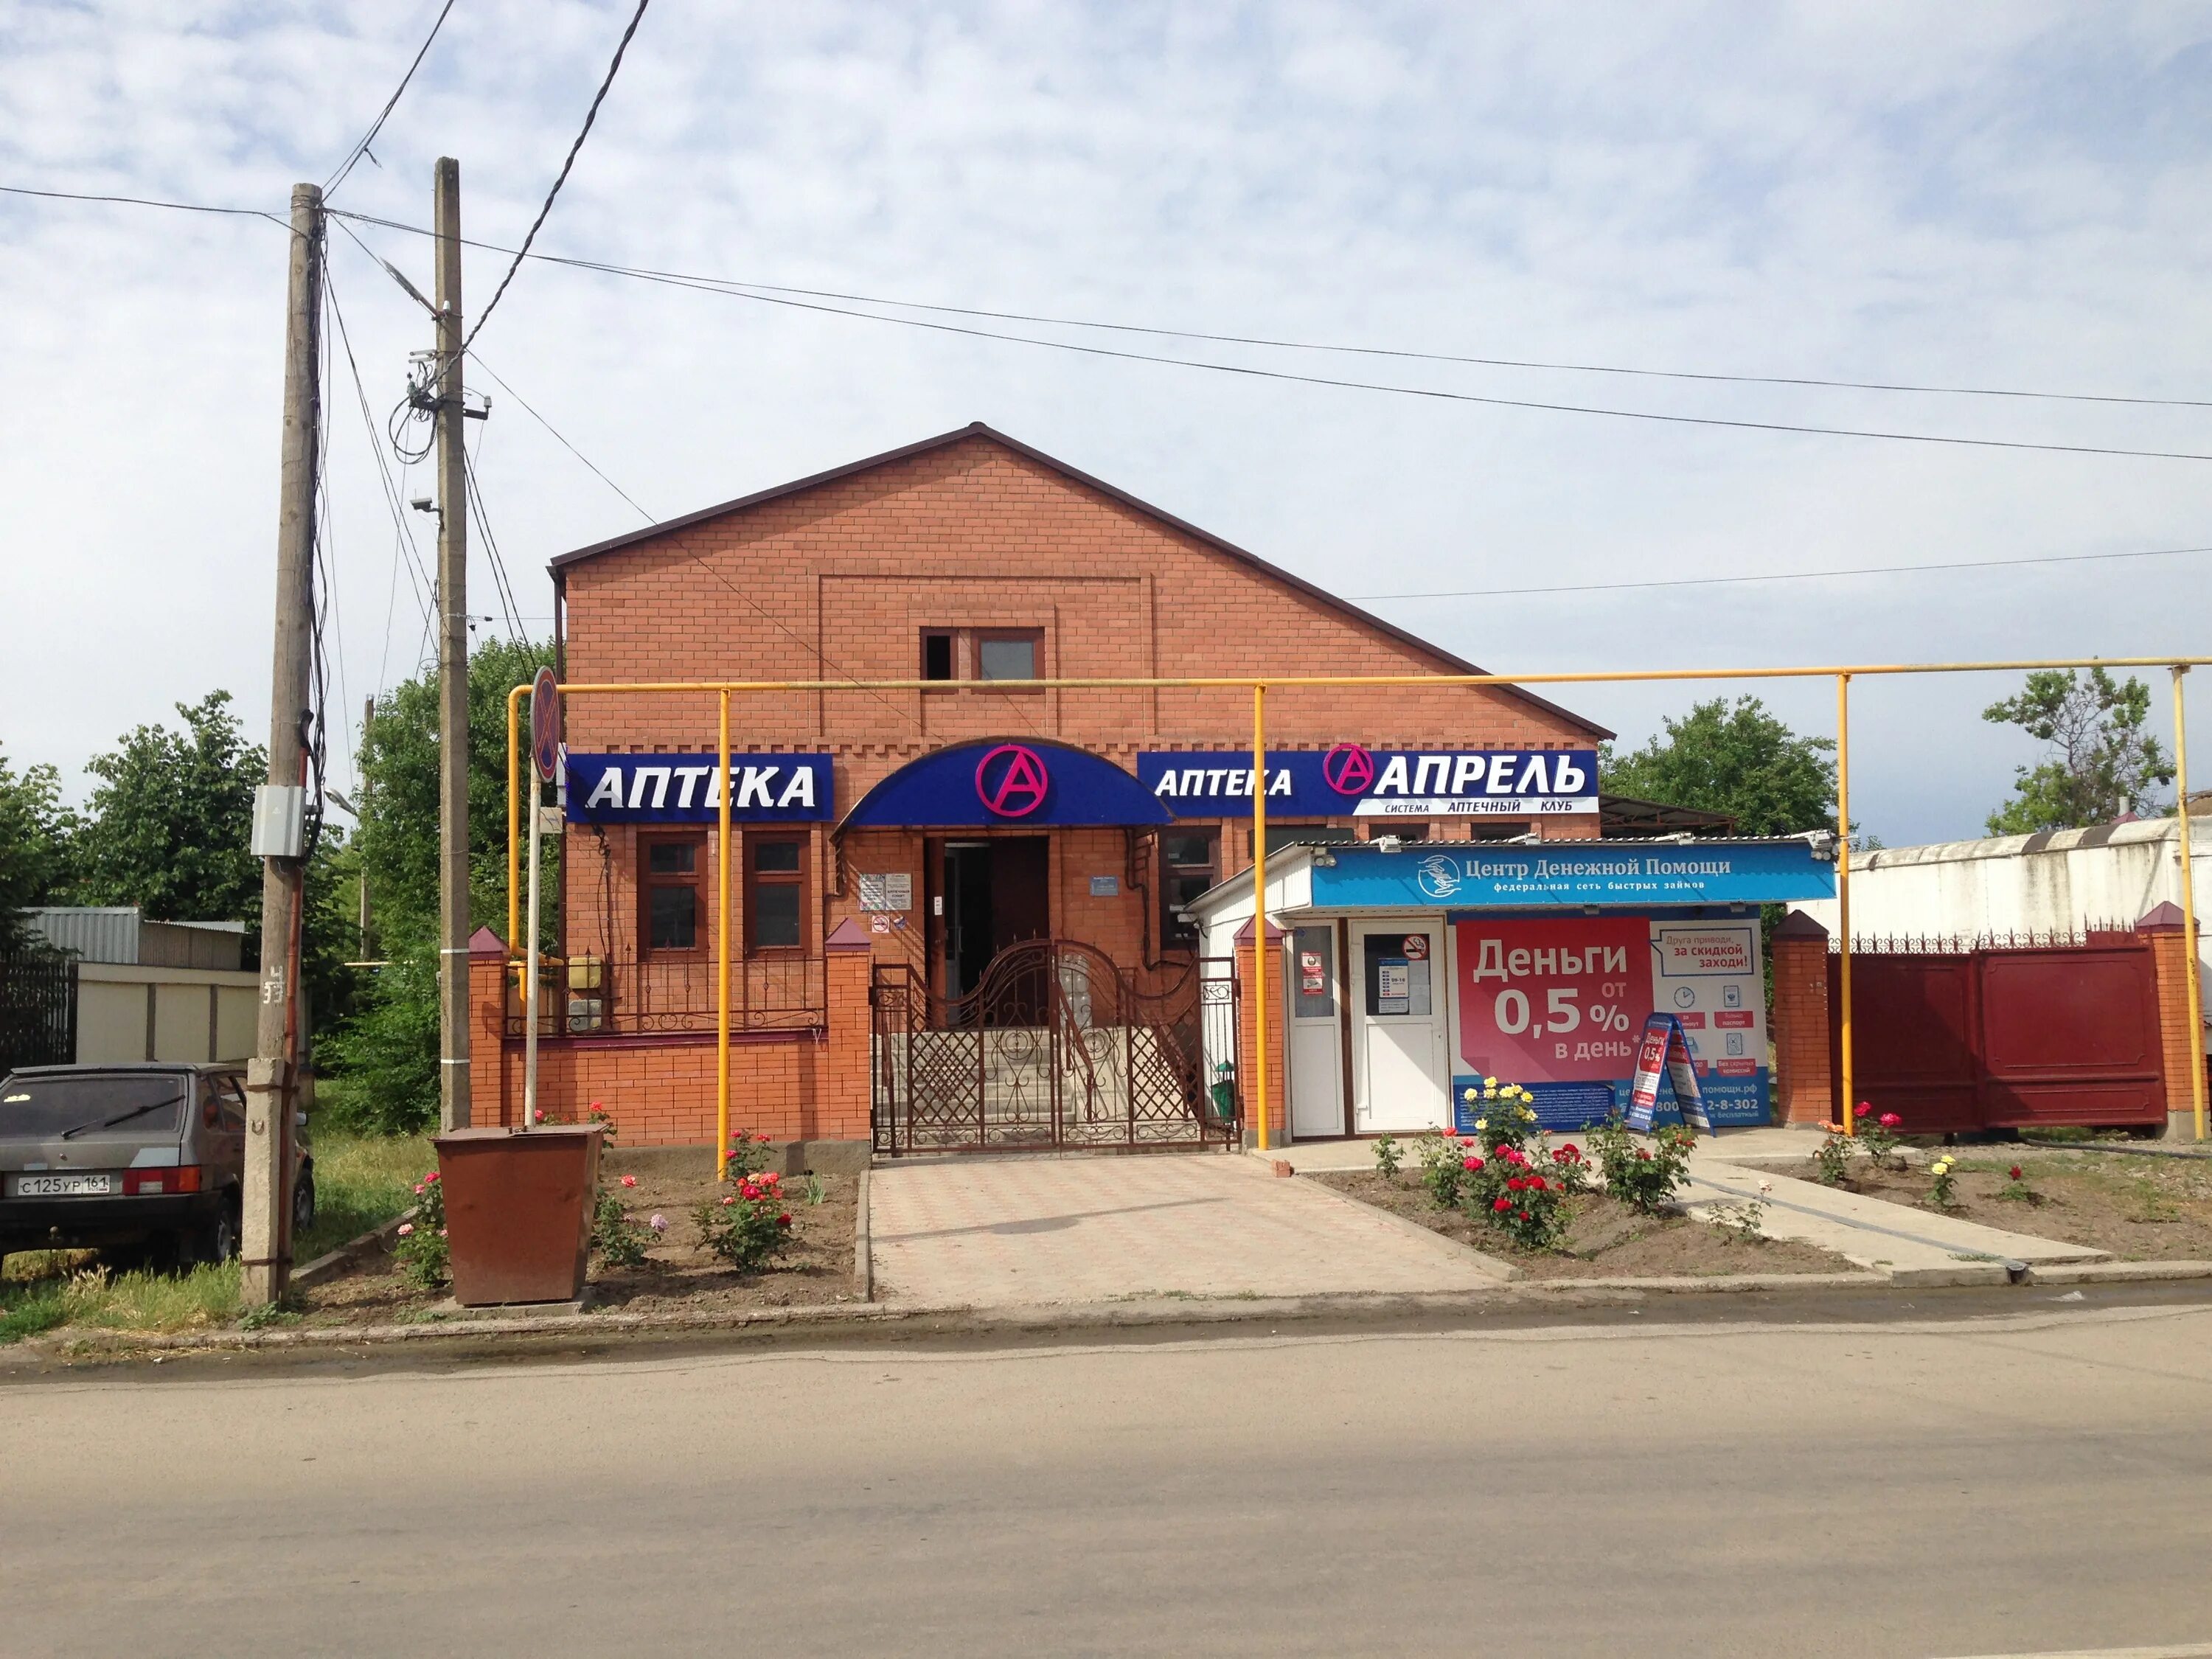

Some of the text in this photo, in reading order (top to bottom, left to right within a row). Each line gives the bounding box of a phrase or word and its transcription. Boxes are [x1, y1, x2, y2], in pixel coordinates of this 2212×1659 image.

[1373, 755, 1585, 794] АПРЕЛЬ
[585, 765, 815, 808] АПТЕКА
[1154, 769, 1292, 796] АПТЕКА
[1385, 799, 1573, 813] СИСТЕМА АПТЕЧНЫЙ КЛУБ
[1465, 858, 1731, 879] Центр Денежной Помощи
[1494, 880, 1705, 892] федеральная сеть быстрых займов
[1666, 936, 1734, 946] Друга приводи,
[1674, 944, 1742, 956] за скидкой
[1473, 939, 1627, 983] Деньги
[1699, 956, 1747, 968] заходи!
[1601, 982, 1627, 998] от
[1495, 988, 1630, 1039] 0,5 %
[1645, 1032, 1665, 1046] Деньги
[1555, 1043, 1568, 1059] в
[1644, 1046, 1656, 1061] 0,5
[84, 1177, 106, 1187] 161
